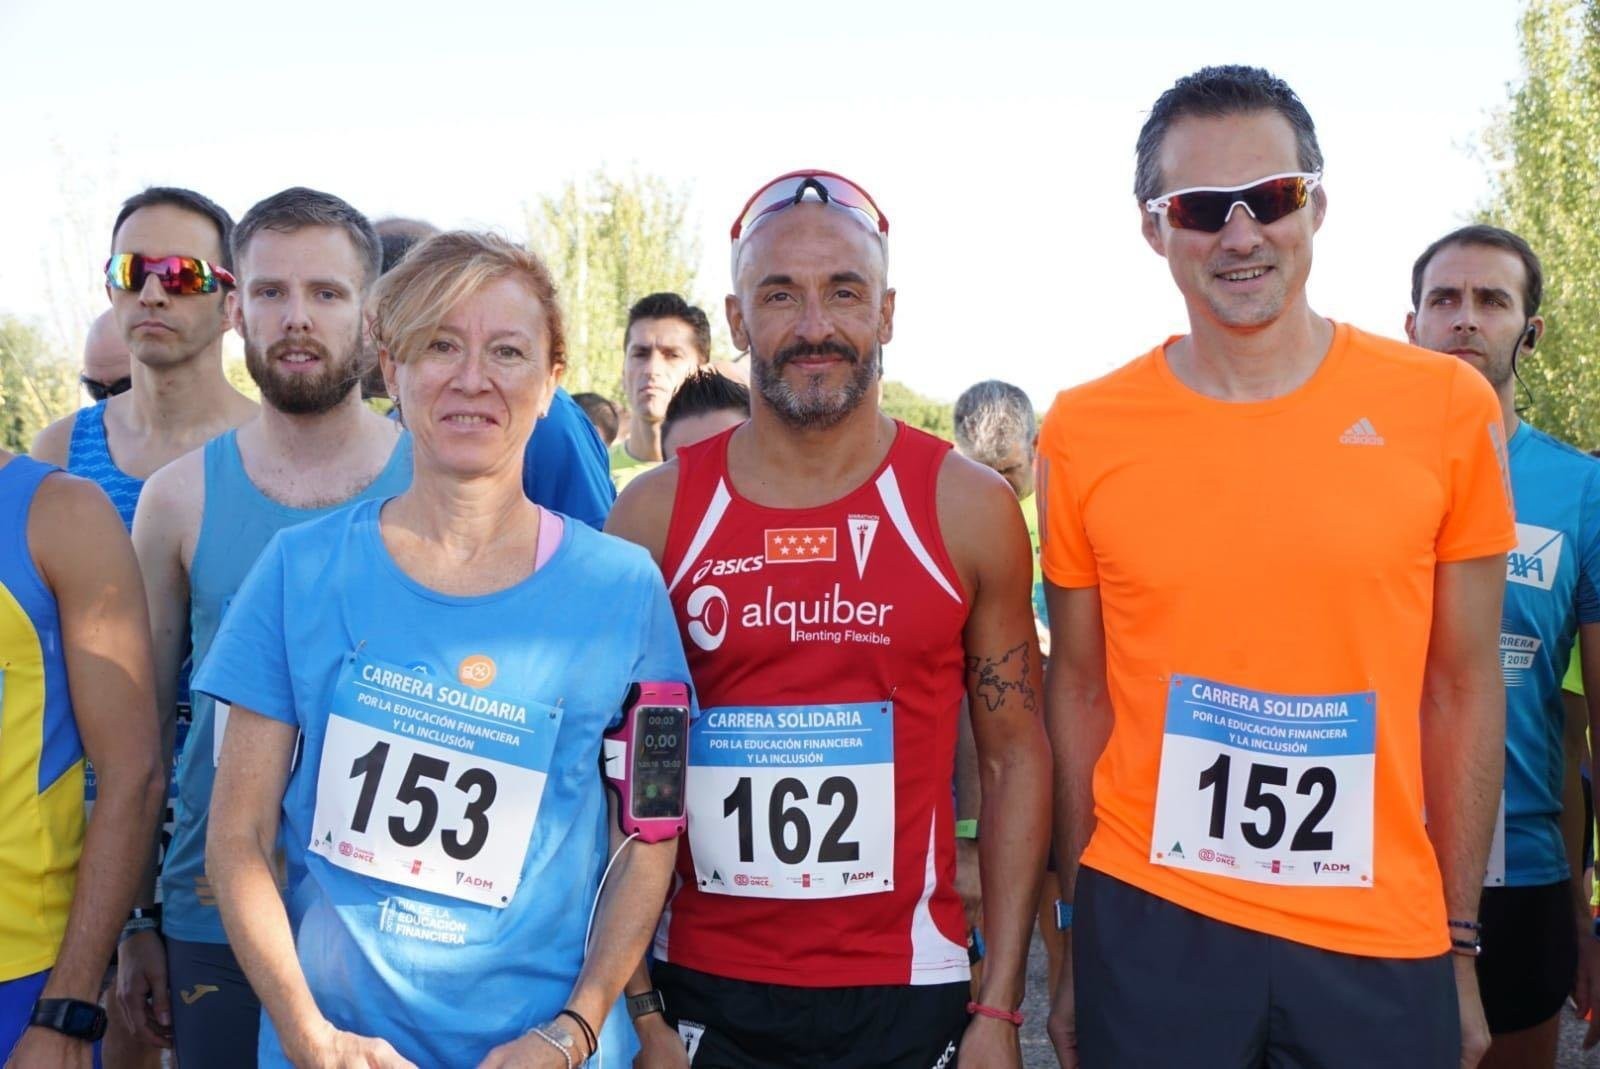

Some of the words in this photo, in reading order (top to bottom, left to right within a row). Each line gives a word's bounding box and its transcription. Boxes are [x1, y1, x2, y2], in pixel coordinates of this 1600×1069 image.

[1506, 553, 1543, 582] AXA
[742, 583, 893, 642] alquiber
[796, 630, 841, 643] Renting
[845, 629, 891, 645] Flexible
[1507, 655, 1528, 665] 2015
[362, 664, 434, 700] CARRERA
[437, 687, 527, 724] SOLIDARIA
[1191, 683, 1260, 713] CARRERA
[1263, 699, 1348, 718] SOLIDARIA
[357, 693, 379, 709] POR
[378, 697, 392, 712] LA
[393, 701, 456, 730] EDUCACIÓN
[457, 717, 521, 747] FINANCIERA
[708, 712, 774, 729] CARRERA
[777, 710, 862, 728] SOLIDARIA
[1192, 710, 1213, 723] POR
[1214, 715, 1226, 726] LA
[1227, 718, 1287, 739] EDUCACIÓN
[1288, 728, 1348, 739] FINANCIERA
[392, 719, 399, 730] Y
[400, 721, 416, 736] LA
[417, 723, 476, 750] INCLUSIÓN
[645, 734, 677, 750] 0,00
[709, 739, 729, 749] POR
[730, 739, 743, 749] LA
[744, 738, 802, 750] EDUCACIÓN
[803, 737, 863, 749] FINANCIERA
[1229, 732, 1236, 743] Y
[1237, 734, 1250, 746] LA
[1251, 737, 1308, 753] INCLUSIÓN
[747, 753, 755, 764] Y
[755, 753, 768, 764] LA
[769, 751, 824, 764] INCLUSIÓN
[349, 740, 498, 861] 153
[1198, 753, 1337, 852] 152
[723, 775, 860, 865] 162
[353, 852, 374, 863] ONCE
[1215, 856, 1235, 866] ONCE
[1322, 863, 1350, 872] ADM
[464, 875, 493, 889] ADM
[850, 871, 874, 880] ADM
[437, 907, 450, 918] LA
[395, 923, 466, 945] FINANCIERA
